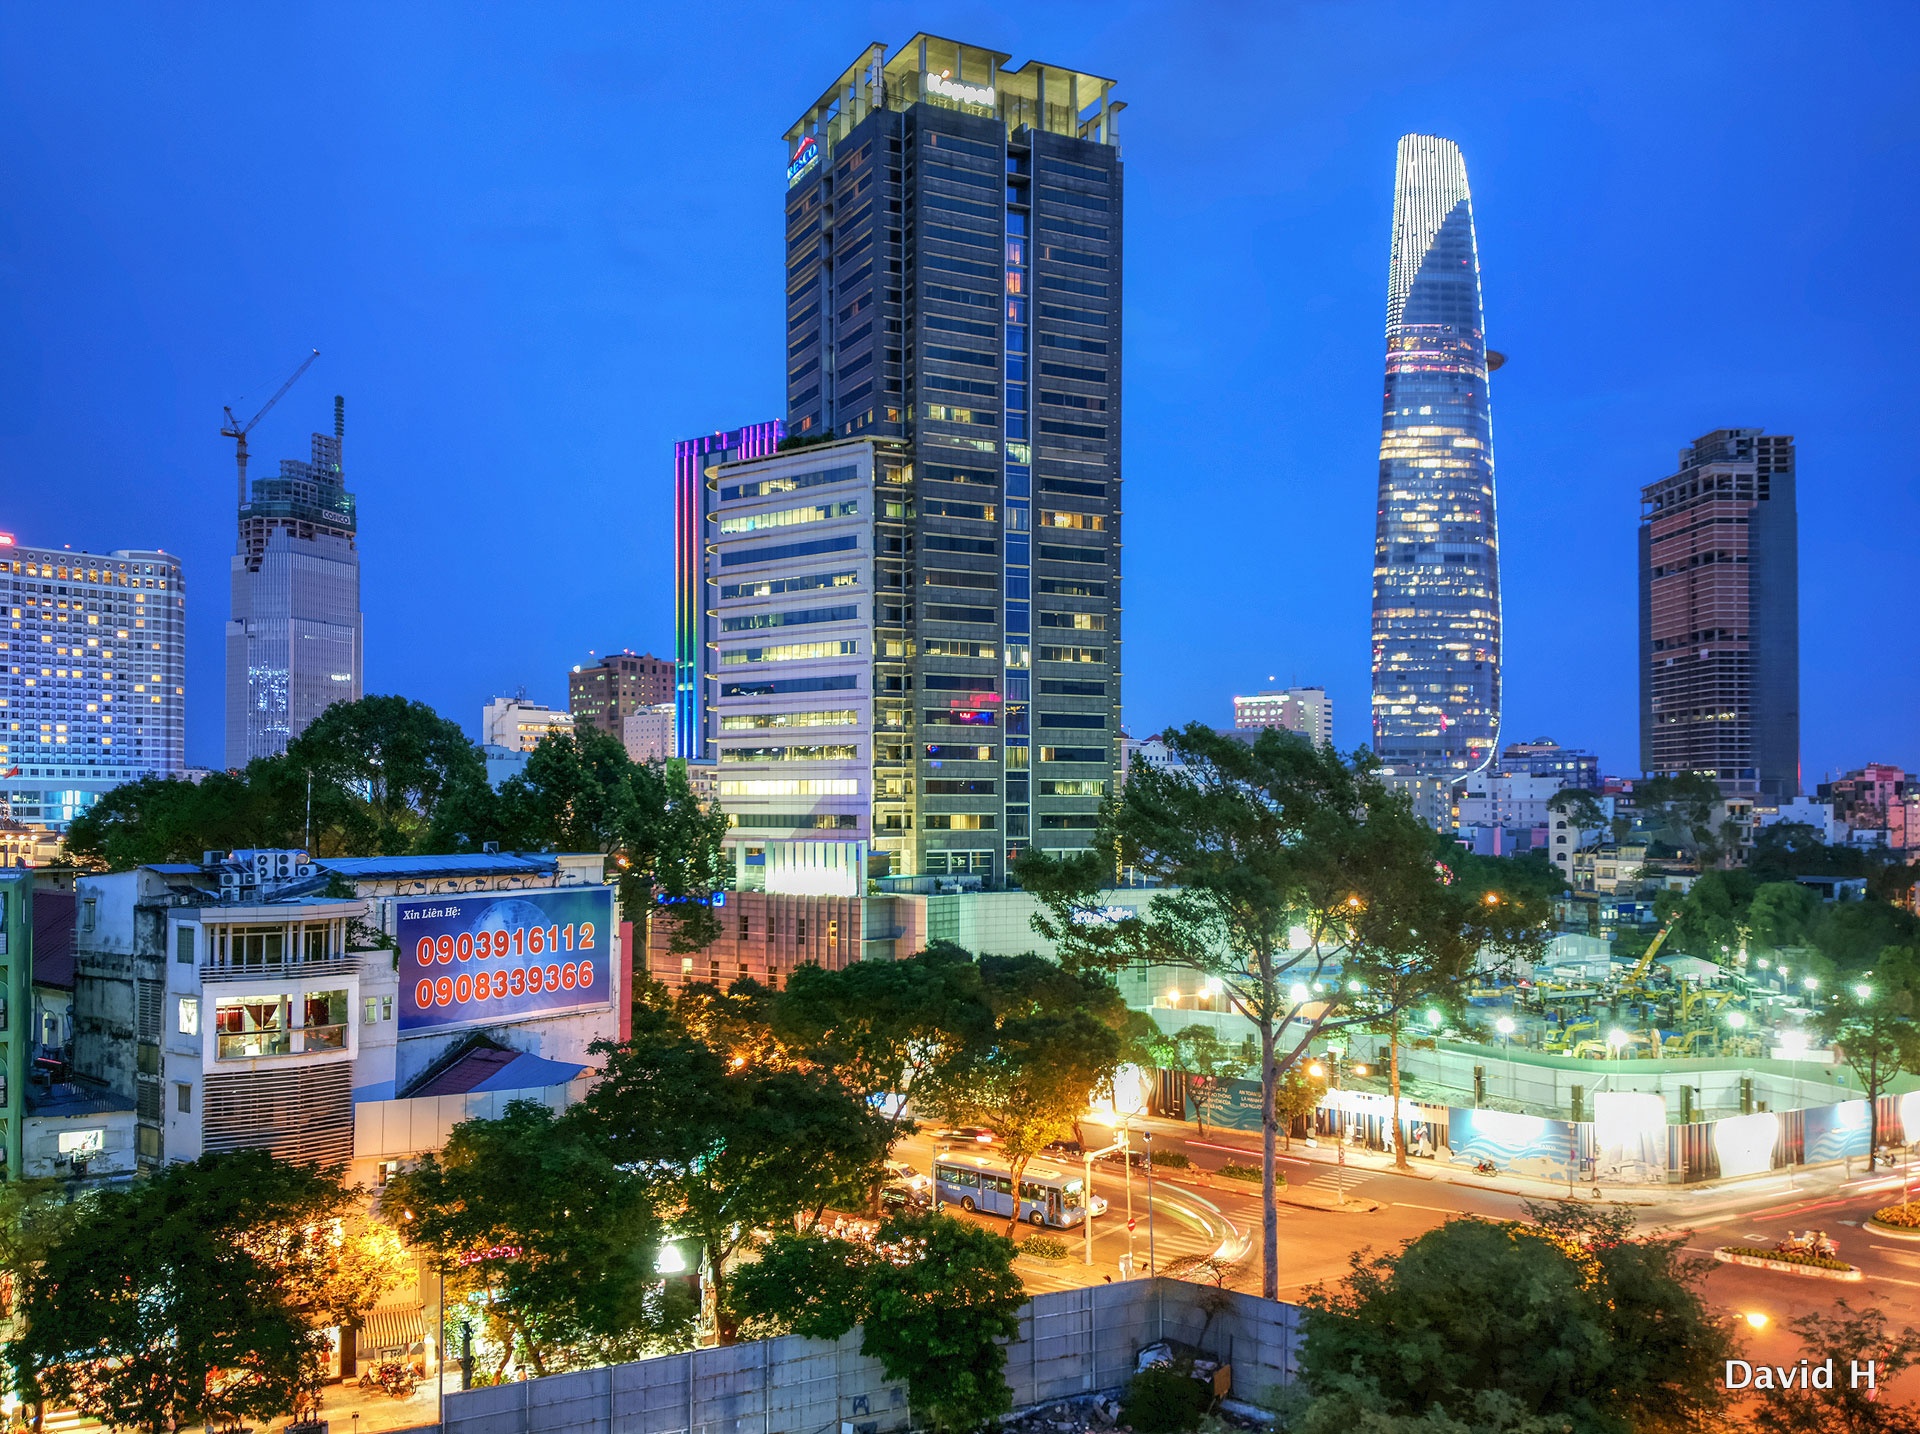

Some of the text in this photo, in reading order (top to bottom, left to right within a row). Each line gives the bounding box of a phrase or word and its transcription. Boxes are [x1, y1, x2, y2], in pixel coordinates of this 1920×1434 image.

[403, 906, 461, 920] Xin Liên Hệ:
[416, 922, 595, 967] 0903916112
[414, 960, 594, 1010] 0908339366
